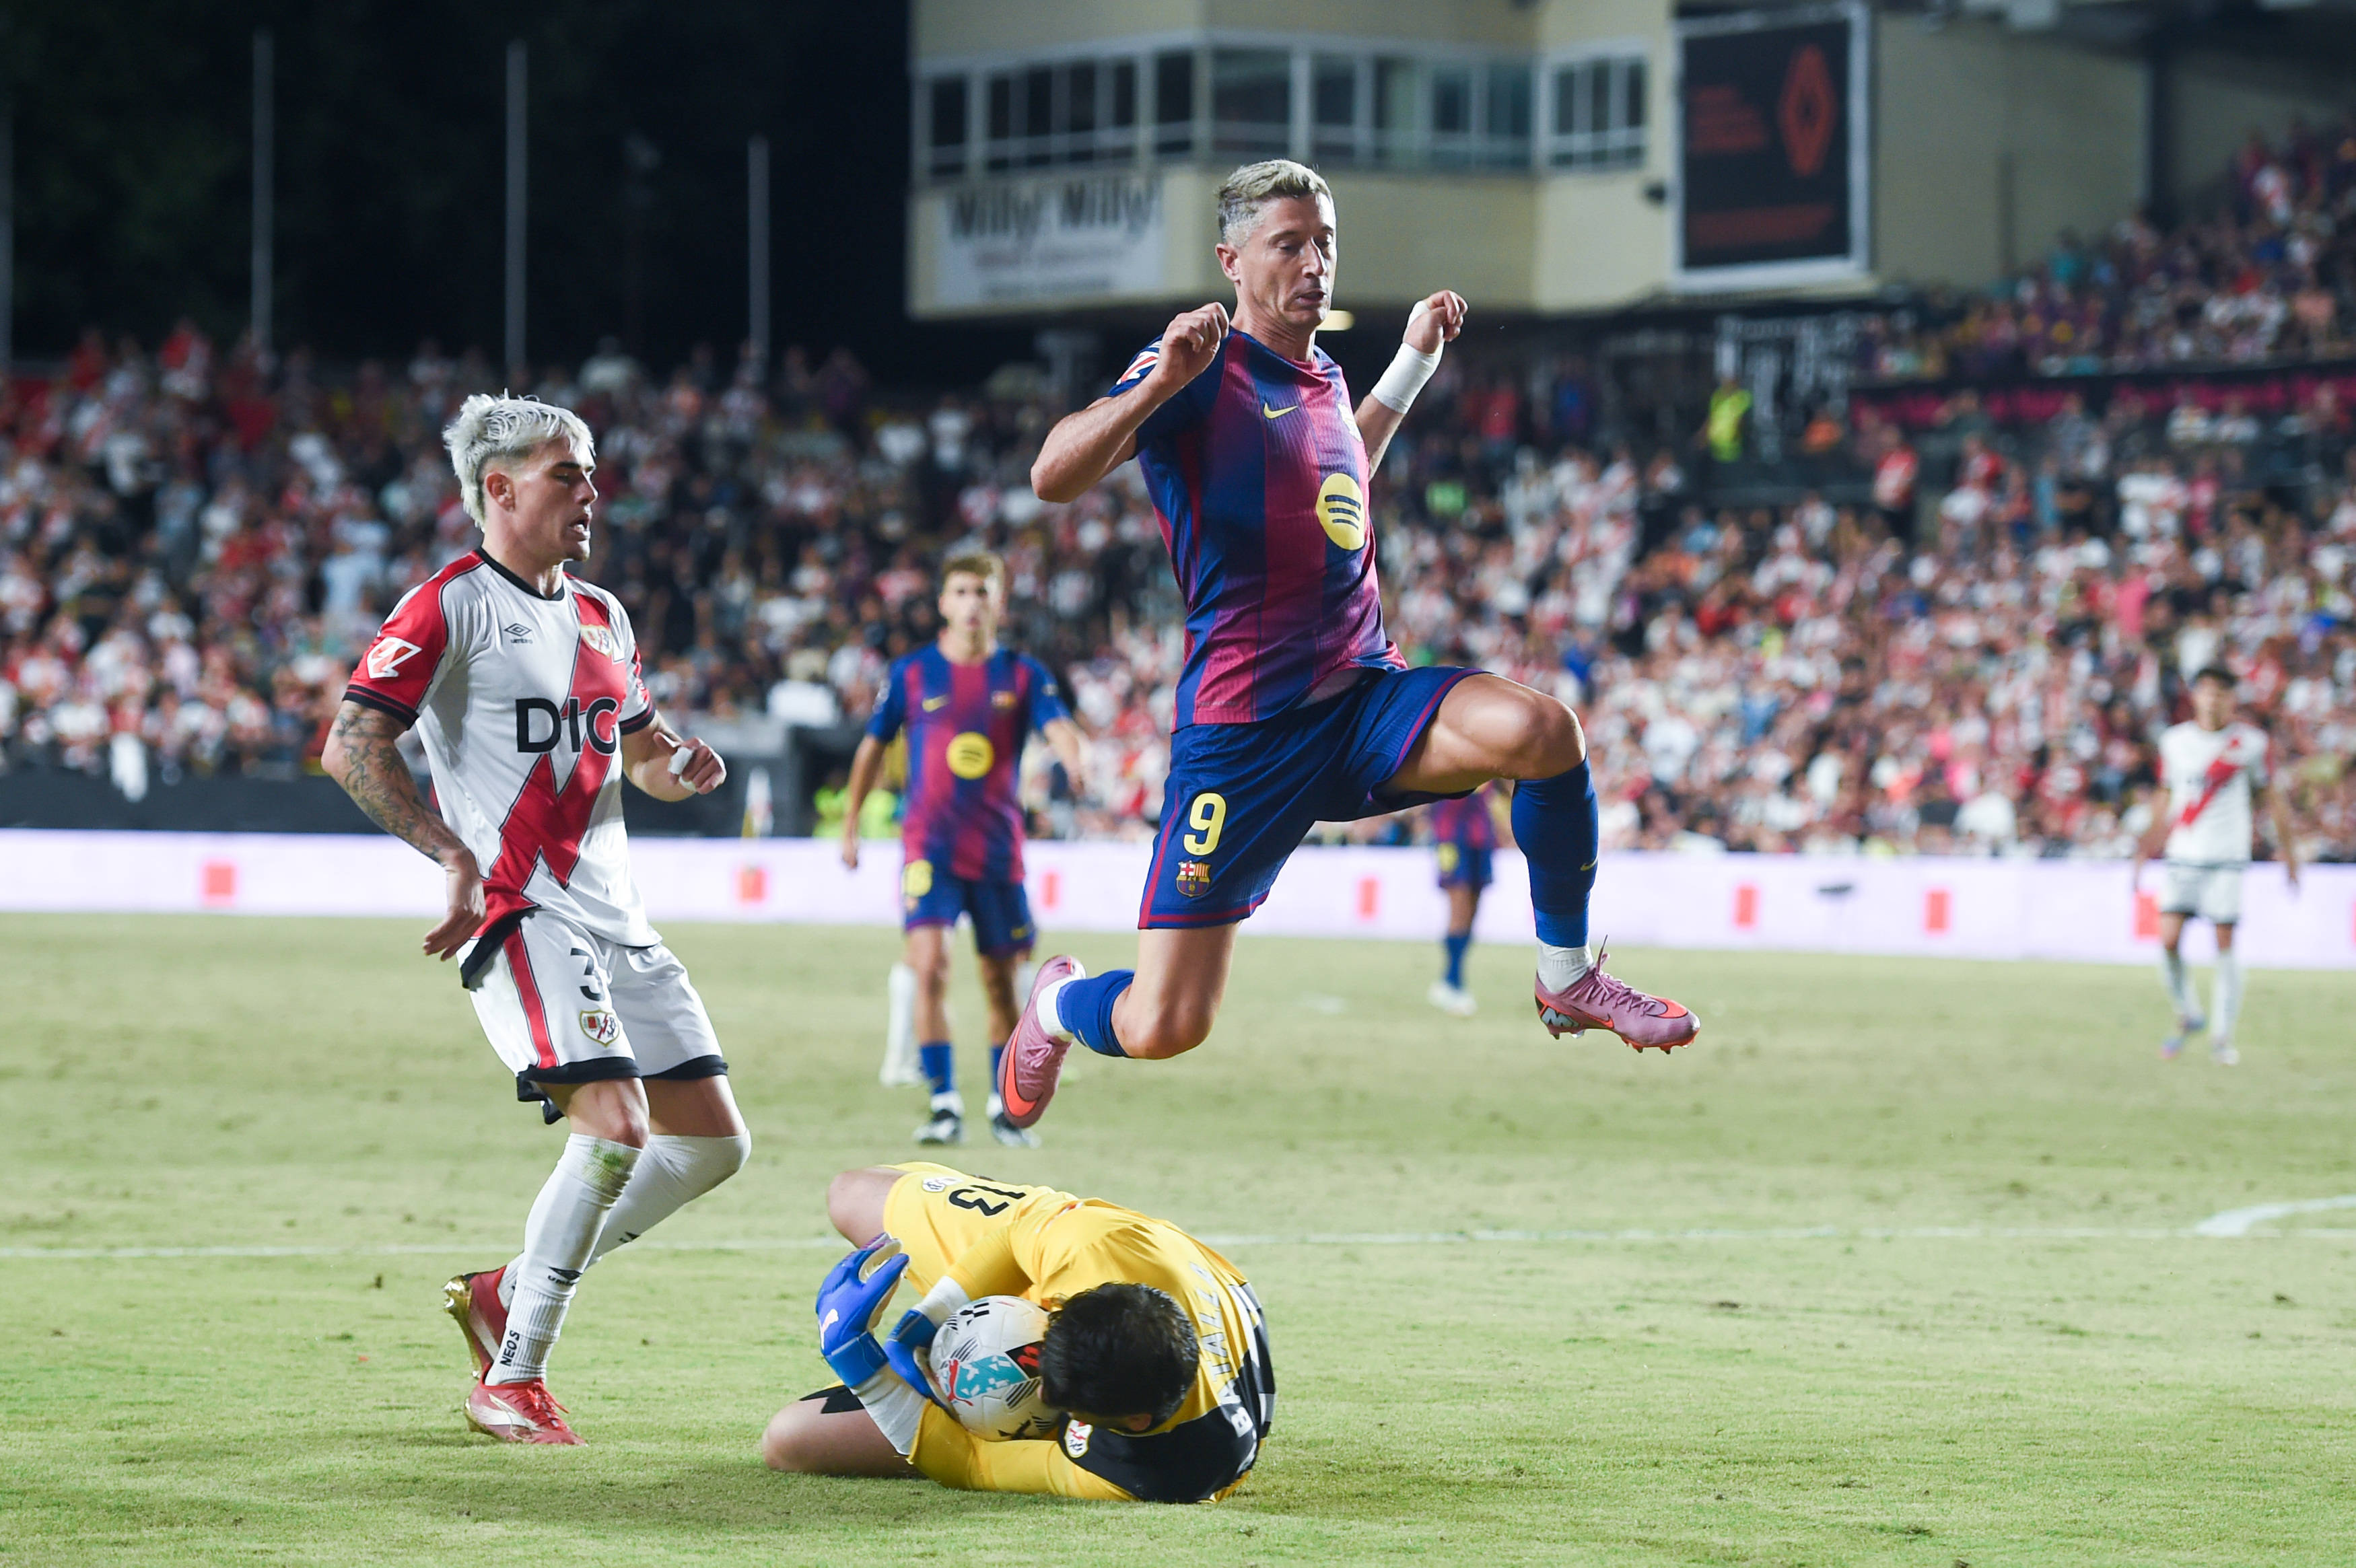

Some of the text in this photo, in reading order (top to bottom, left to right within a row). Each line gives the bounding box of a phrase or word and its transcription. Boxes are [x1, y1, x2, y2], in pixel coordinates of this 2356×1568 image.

[1183, 792, 1226, 856] 9
[570, 948, 604, 1001] 3
[948, 1184, 1027, 1217] 13
